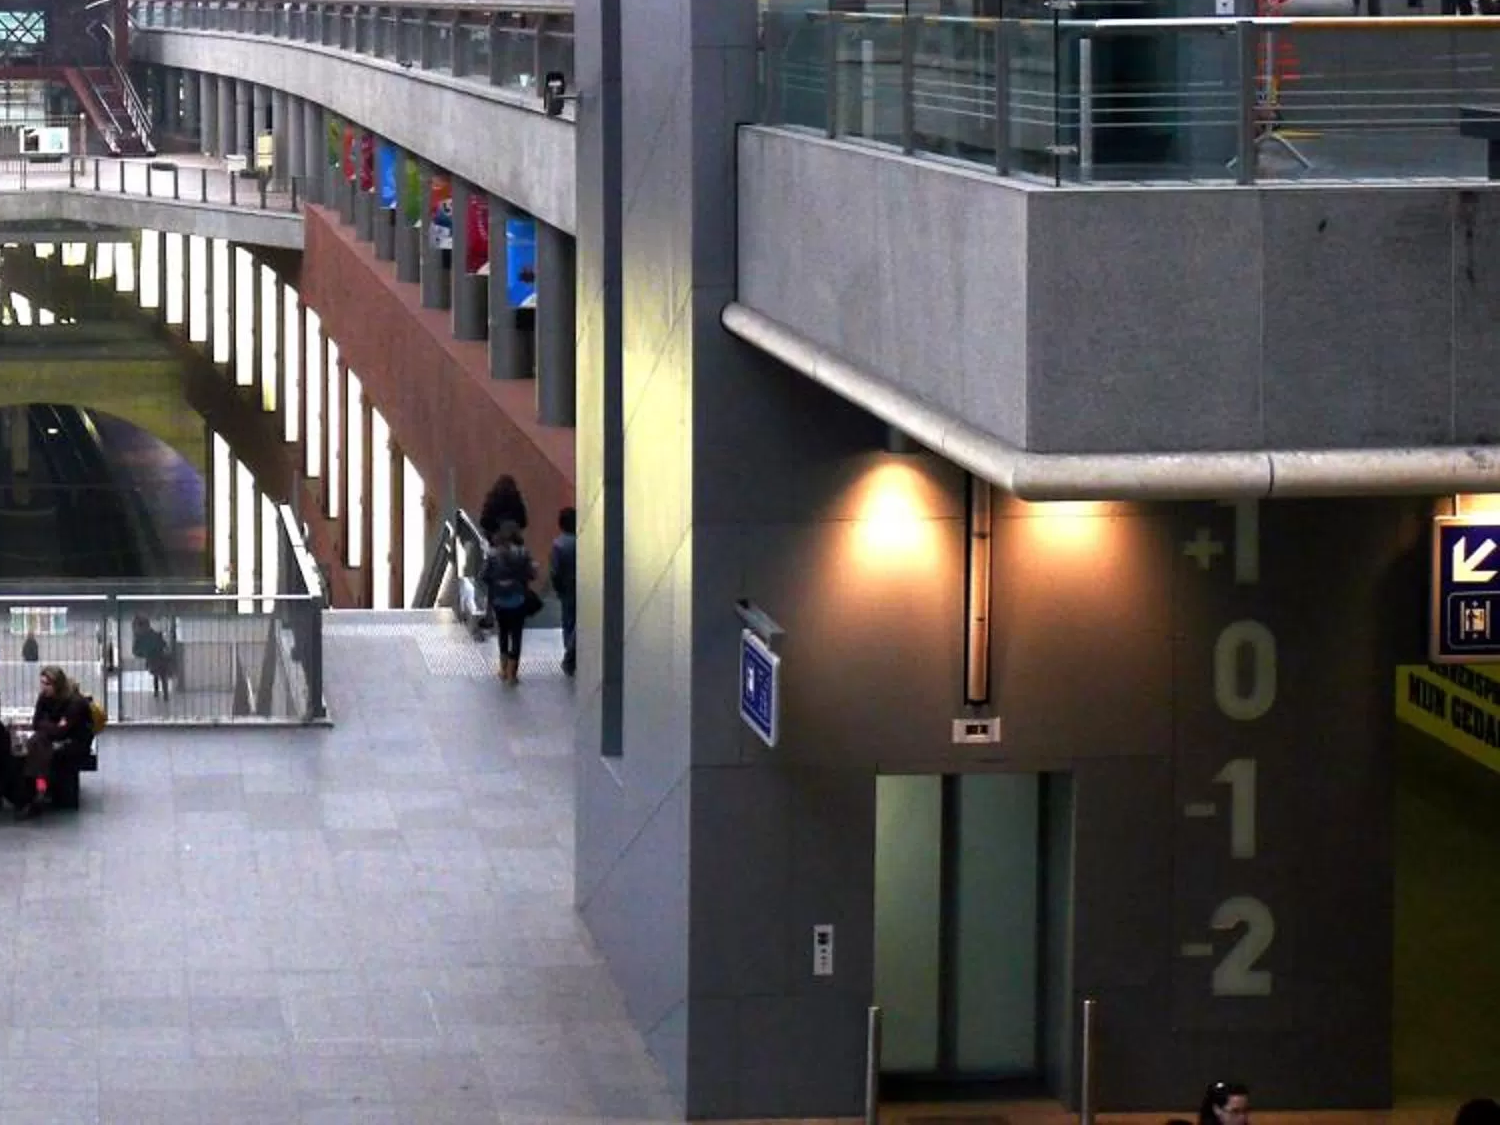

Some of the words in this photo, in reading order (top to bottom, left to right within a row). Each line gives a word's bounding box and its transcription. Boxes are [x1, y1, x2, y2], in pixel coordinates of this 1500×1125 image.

[1213, 619, 1278, 722] 0
[1184, 758, 1258, 861] -1
[1181, 896, 1276, 997] -2
